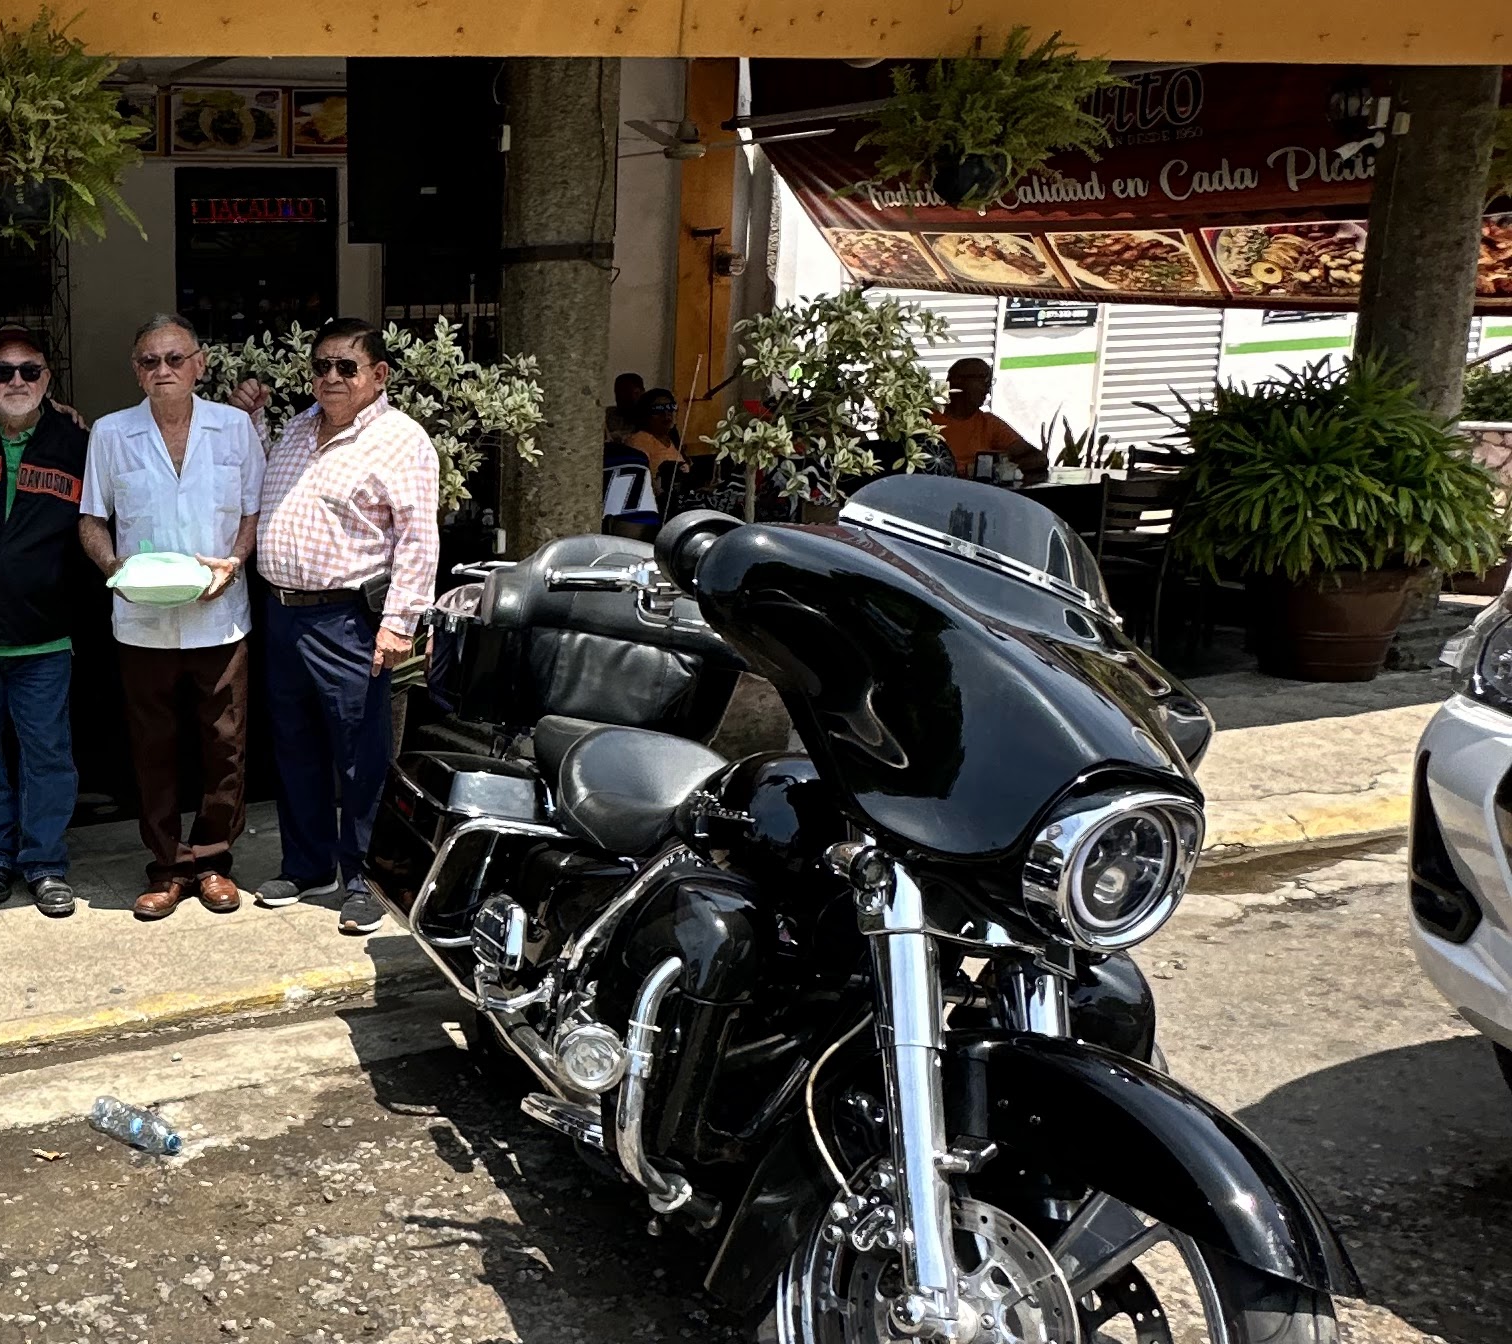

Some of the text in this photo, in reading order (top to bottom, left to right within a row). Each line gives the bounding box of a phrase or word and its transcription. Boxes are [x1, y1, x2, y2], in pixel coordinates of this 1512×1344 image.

[1112, 176, 1150, 199] en
[1159, 158, 1259, 201] Cada
[18, 467, 74, 497] DAVIDSON
